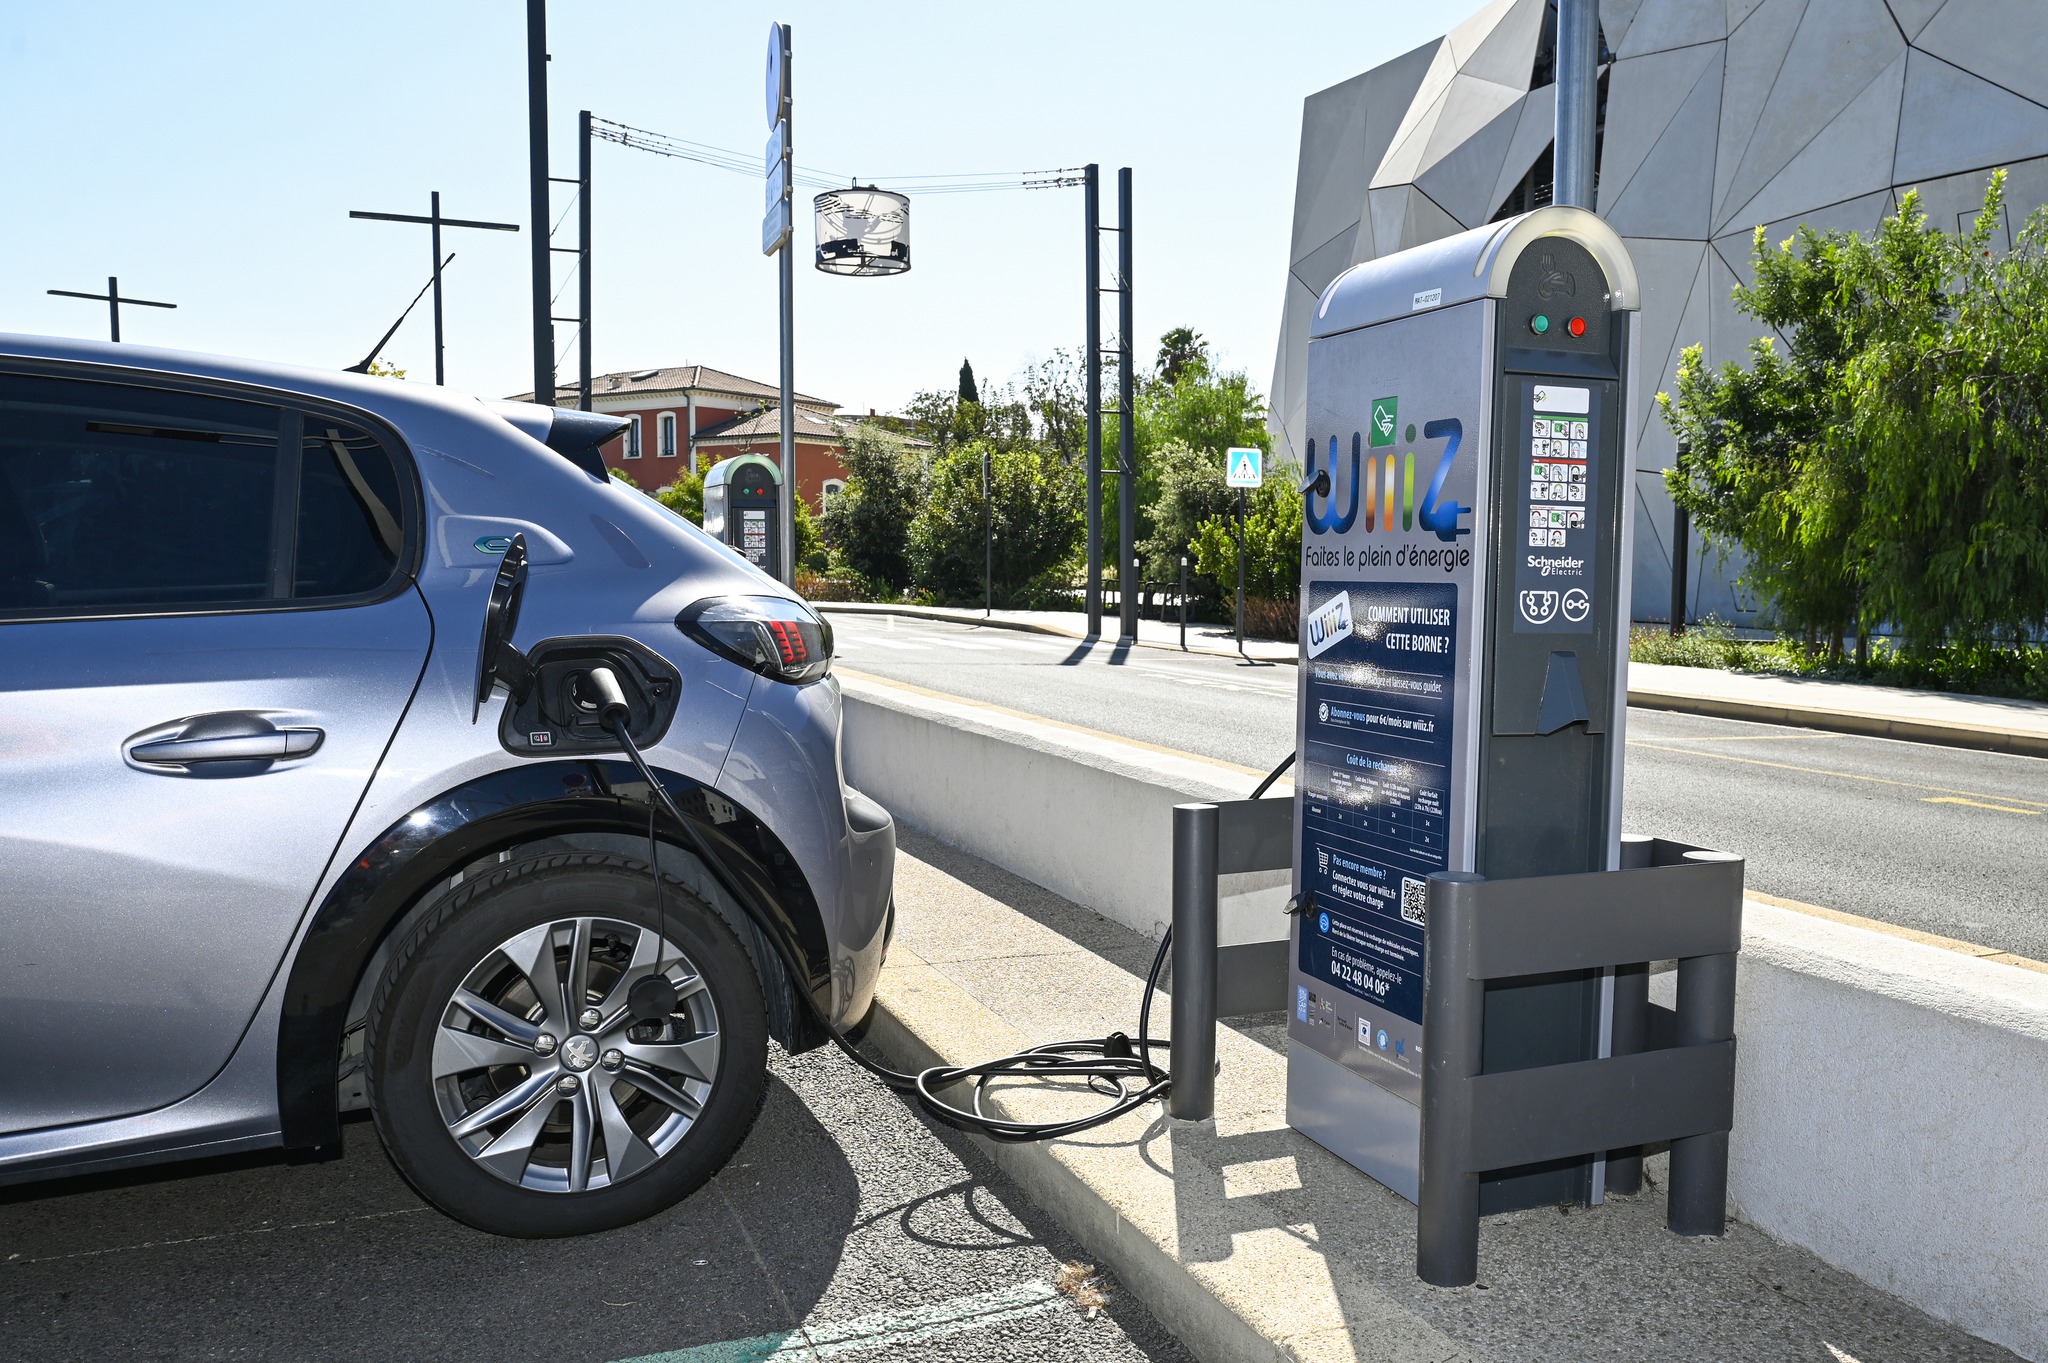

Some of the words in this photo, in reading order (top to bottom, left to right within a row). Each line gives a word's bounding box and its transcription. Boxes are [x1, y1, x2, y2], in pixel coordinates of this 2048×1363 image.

[1305, 545, 1340, 567] Faites
[1343, 544, 1355, 567] le
[1358, 544, 1392, 572] plein
[1395, 543, 1470, 573] d'énergie
[1527, 555, 1584, 569] Schneider
[1551, 567, 1583, 576] Electric
[1367, 605, 1410, 624] COMMENT
[1410, 608, 1450, 626] UTILISER
[1386, 632, 1411, 651] CETTE
[1411, 634, 1442, 654] BORNE
[1443, 636, 1450, 654] ?
[1391, 676, 1423, 691] laissez-vous
[1423, 681, 1443, 694] guider.
[1331, 706, 1366, 722] Abonnez-vous
[1365, 714, 1379, 725] pour
[1379, 714, 1402, 730] 6€/mois
[1402, 719, 1412, 729] sur
[1346, 753, 1359, 765] Coût
[1359, 756, 1366, 767] de
[1366, 758, 1372, 769] la
[1333, 853, 1342, 866] Pas
[1342, 860, 1359, 872] encore
[1359, 864, 1382, 879] membre
[1382, 869, 1387, 880] ?
[1332, 869, 1357, 887] Connectez
[1356, 880, 1368, 890] vous
[1368, 884, 1377, 893] sur
[1332, 883, 1338, 892] et
[1338, 884, 1353, 898] réglez
[1353, 891, 1366, 903] votre
[1366, 893, 1384, 910] charge
[1331, 946, 1338, 957] En
[1338, 950, 1346, 961] cas
[1345, 952, 1352, 964] de
[1351, 956, 1376, 975] problème,
[1376, 966, 1402, 985] appelez-le
[1331, 960, 1341, 977] 04
[1341, 964, 1351, 982] 22
[1352, 969, 1362, 987] 48
[1363, 973, 1374, 992] 04
